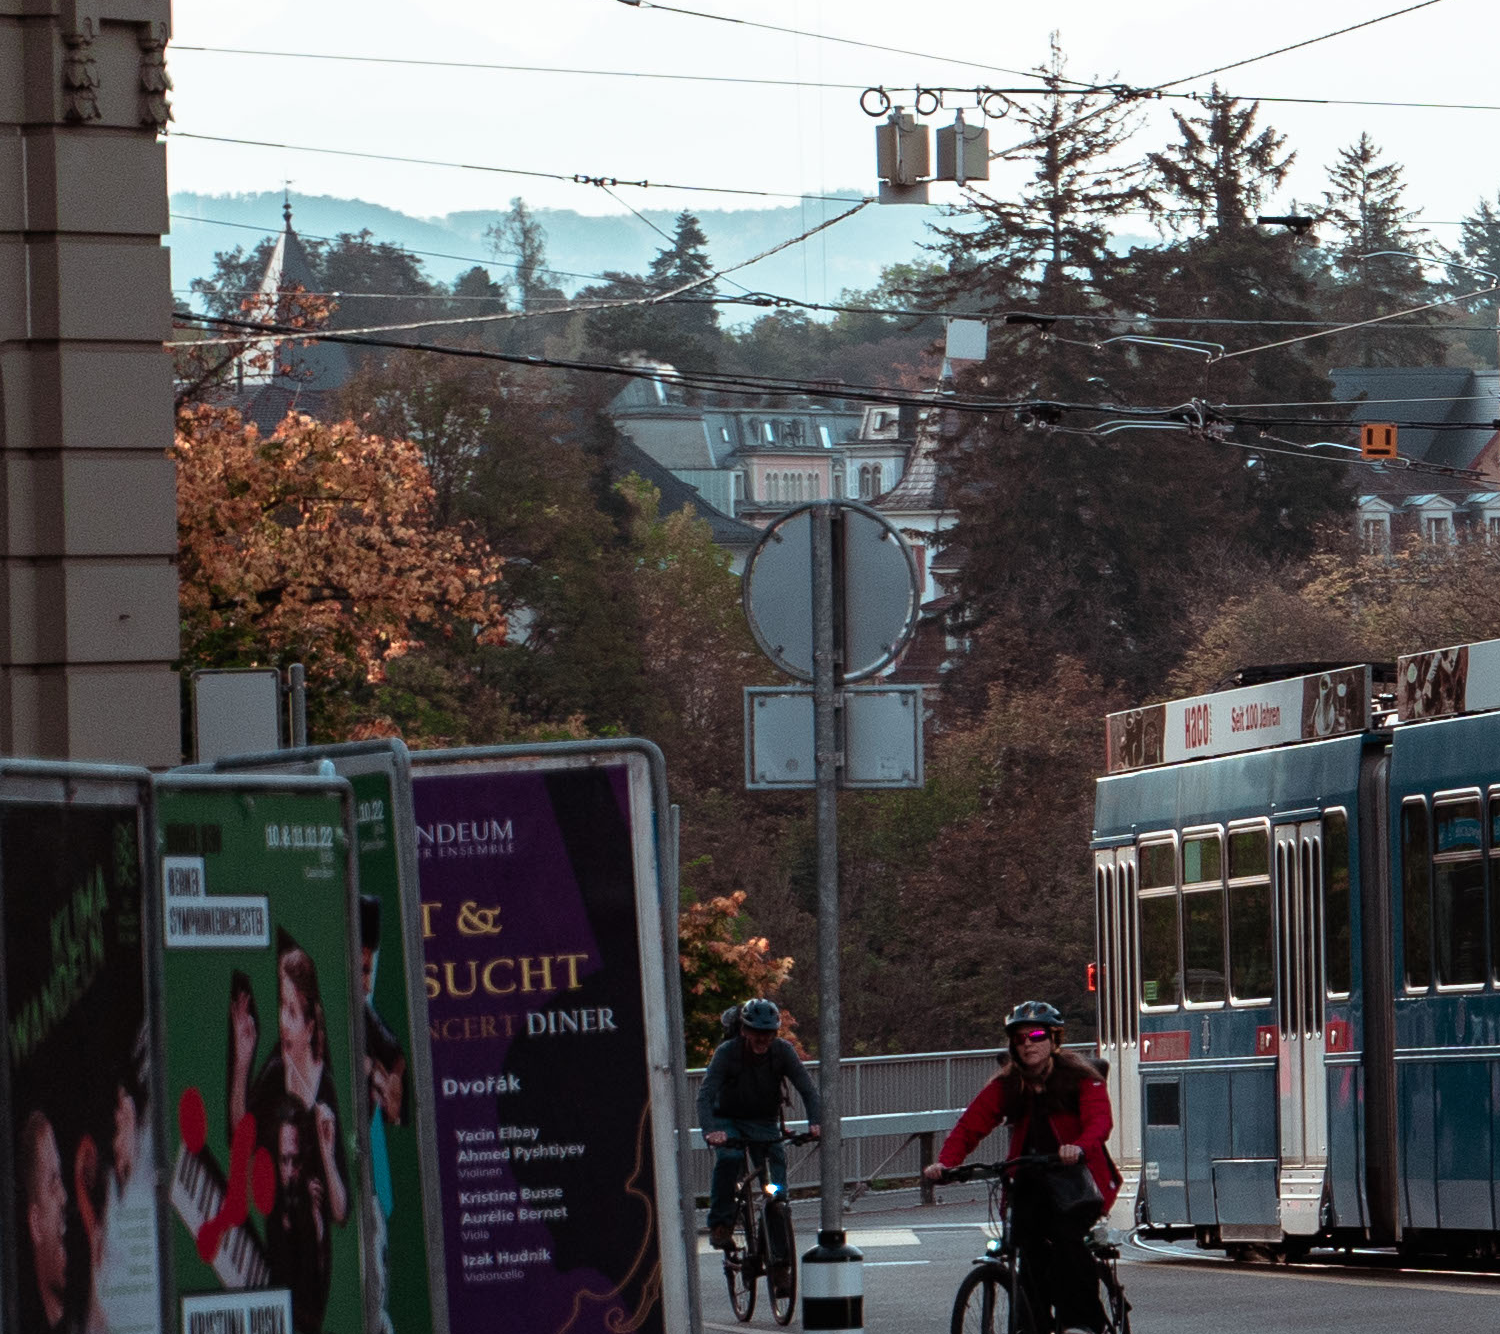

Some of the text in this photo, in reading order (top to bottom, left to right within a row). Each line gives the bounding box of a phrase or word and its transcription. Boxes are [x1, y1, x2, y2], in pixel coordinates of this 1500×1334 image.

[1232, 706, 1244, 732] Seit
[1246, 703, 1258, 730] 100
[1260, 702, 1281, 729] Jahren
[416, 818, 514, 845] NDEUM
[439, 842, 516, 858] ENSEMBLE
[421, 899, 503, 938] T &
[425, 952, 588, 1000] SUCHT
[429, 1007, 619, 1041] NCERT DINER
[442, 1072, 522, 1098] Dvořák
[455, 1125, 540, 1143] Yacin Elbay
[457, 1144, 586, 1163] Ahmed Pyshtiyev
[459, 1187, 564, 1205] Kristine Busse
[461, 1207, 569, 1226] Aurélie Bernet
[461, 1230, 491, 1241] Viola
[462, 1248, 552, 1267] Izak Hudnik
